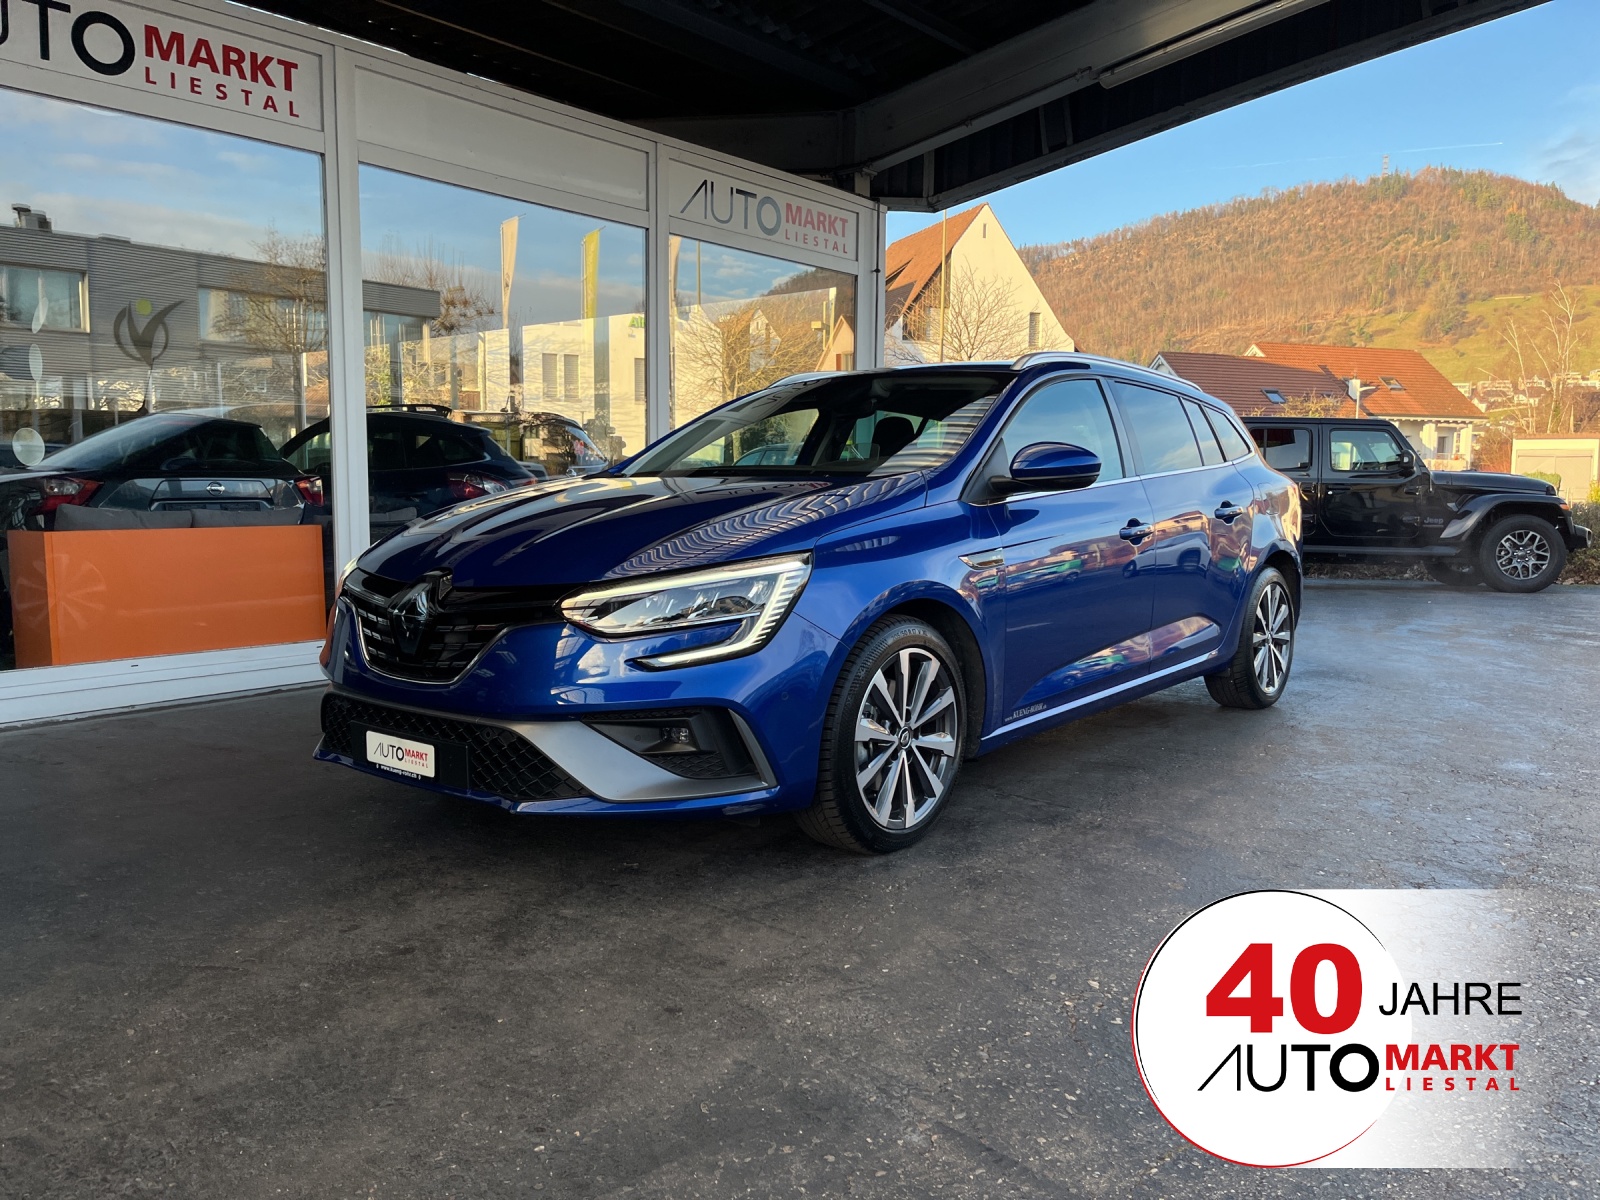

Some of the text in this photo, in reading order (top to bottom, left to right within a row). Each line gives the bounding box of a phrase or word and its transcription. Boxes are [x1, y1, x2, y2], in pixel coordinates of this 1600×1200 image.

[144, 24, 299, 92] MARKT
[144, 67, 300, 118] LIESTAL
[680, 179, 849, 238] AUTO MARKT
[785, 229, 848, 254] LIESTAL
[1424, 517, 1443, 525] Jeep
[374, 742, 428, 762] AUTO MARKT
[405, 758, 428, 768] LIESTAL
